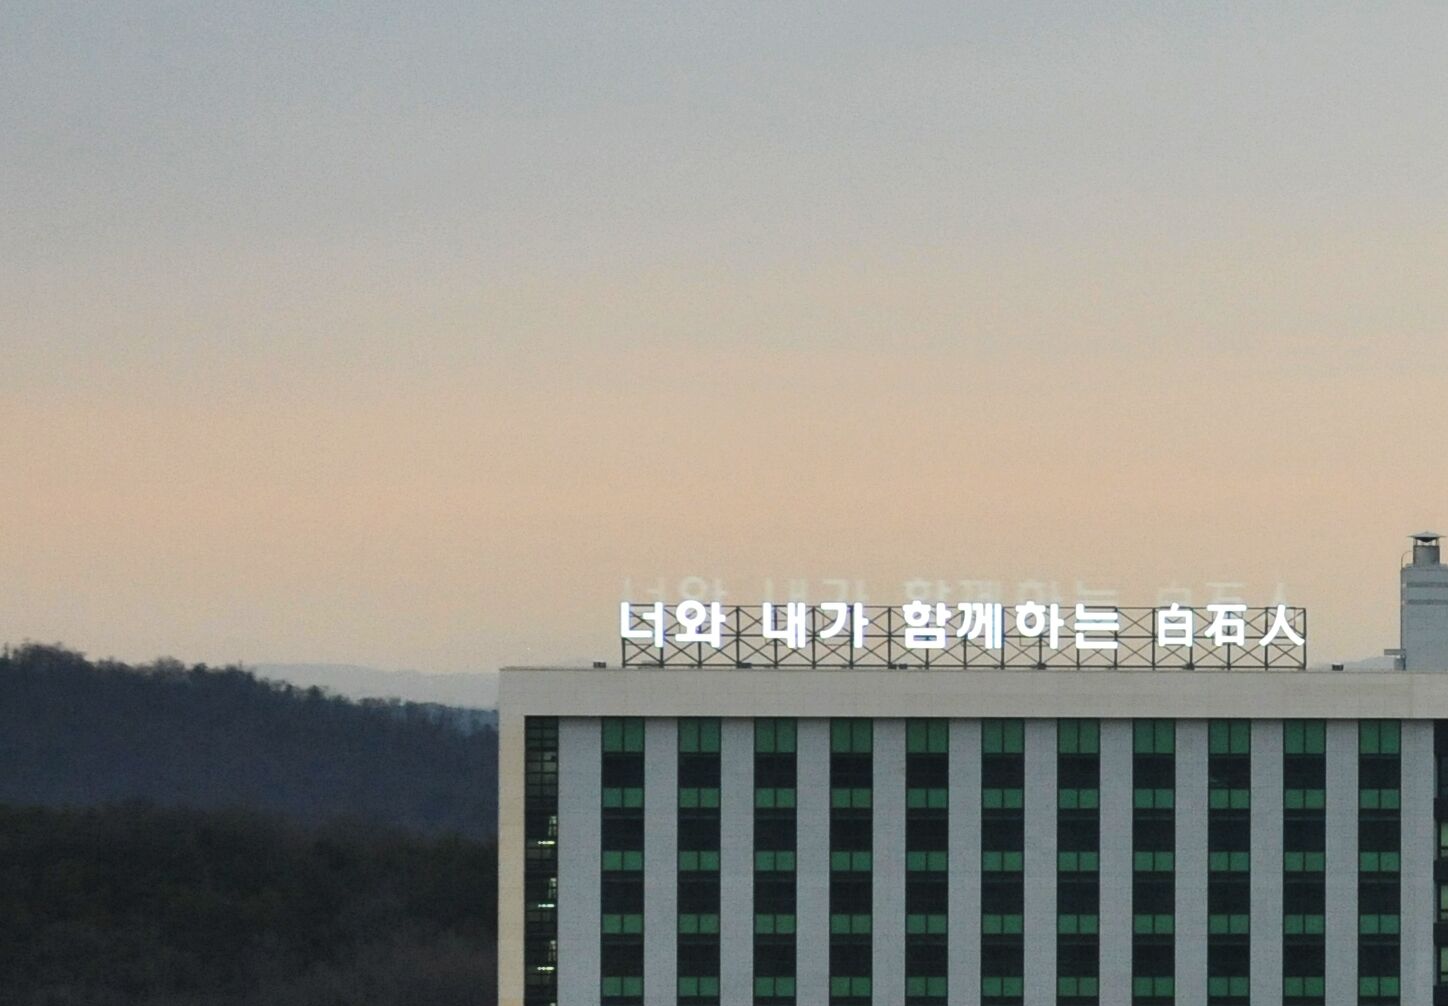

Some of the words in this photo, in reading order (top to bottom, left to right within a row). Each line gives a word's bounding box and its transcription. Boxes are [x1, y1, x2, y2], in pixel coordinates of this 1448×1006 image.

[620, 599, 727, 648] 너와
[762, 602, 869, 649] 내가
[902, 600, 1120, 650] 함께하는
[1158, 602, 1305, 647] 白石人
